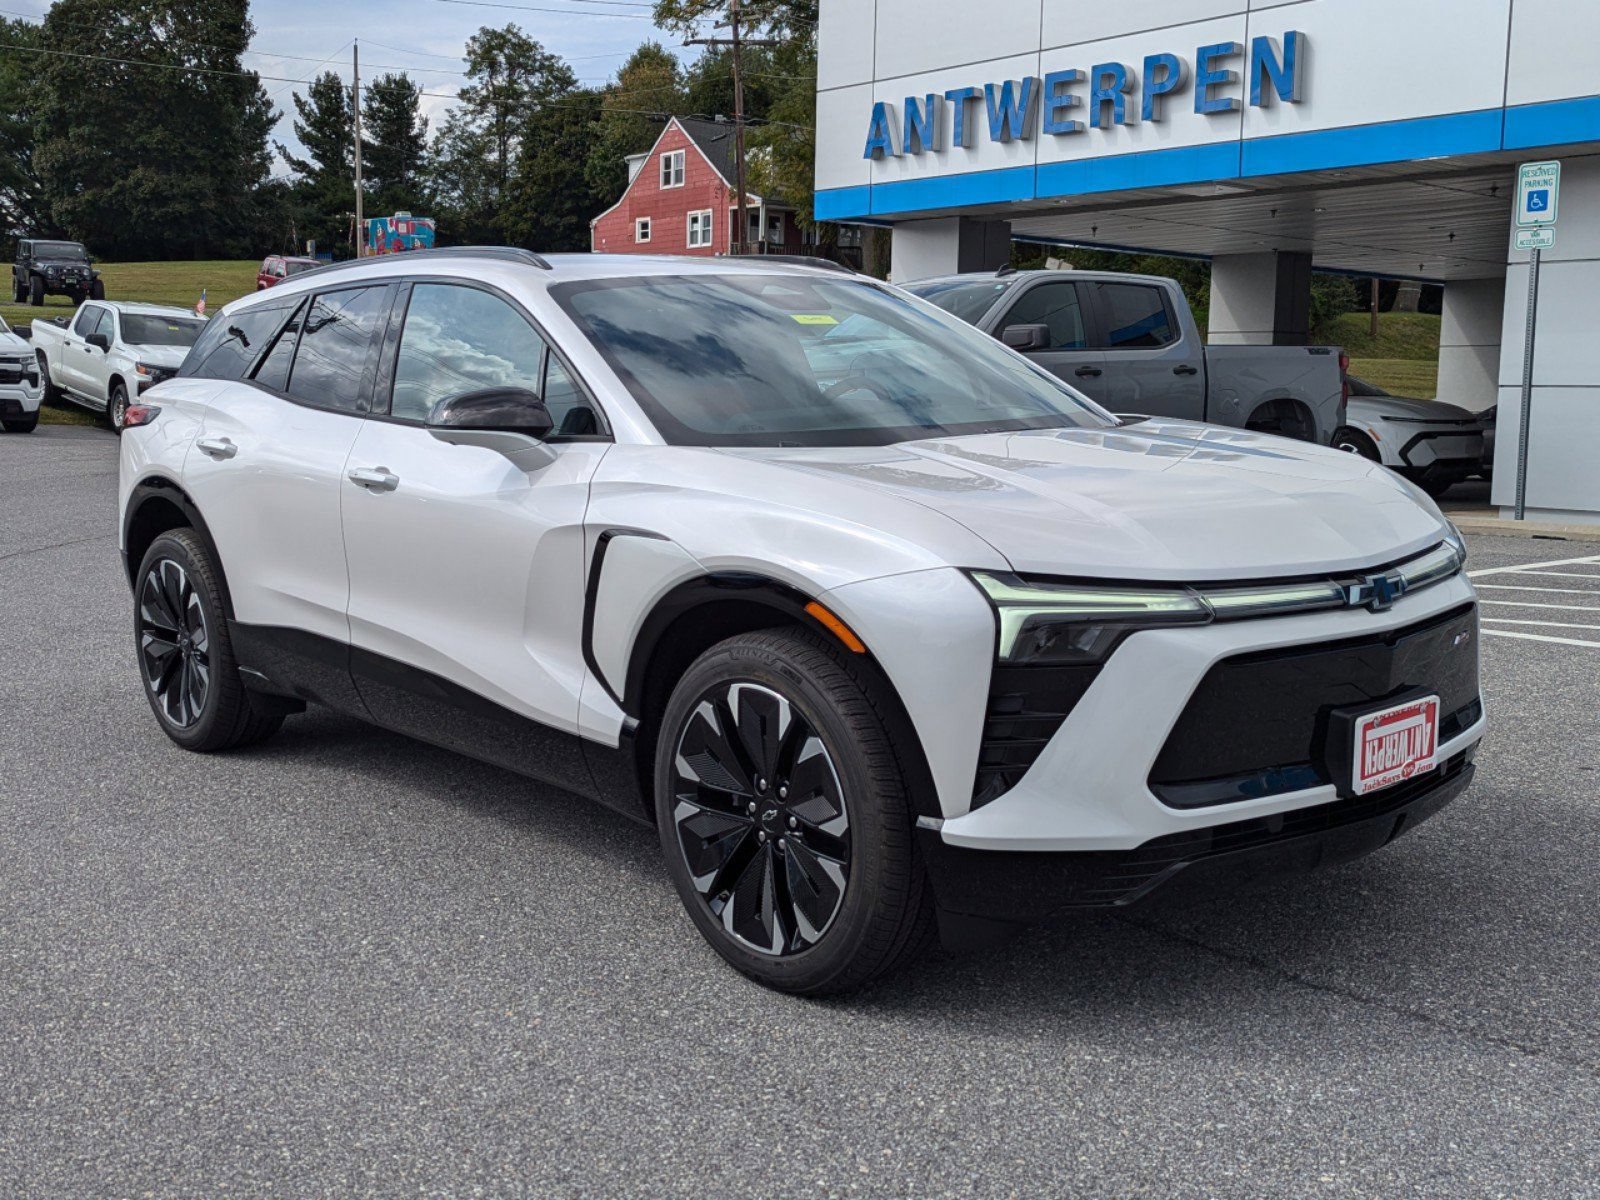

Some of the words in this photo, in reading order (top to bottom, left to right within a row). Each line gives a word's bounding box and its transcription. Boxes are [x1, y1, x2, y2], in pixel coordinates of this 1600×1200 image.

[863, 30, 1305, 160] ANTWERPEN
[1523, 167, 1556, 177] RESERVED
[1524, 178, 1553, 188] PARKING
[1365, 722, 1432, 776] ANTWERPEN
